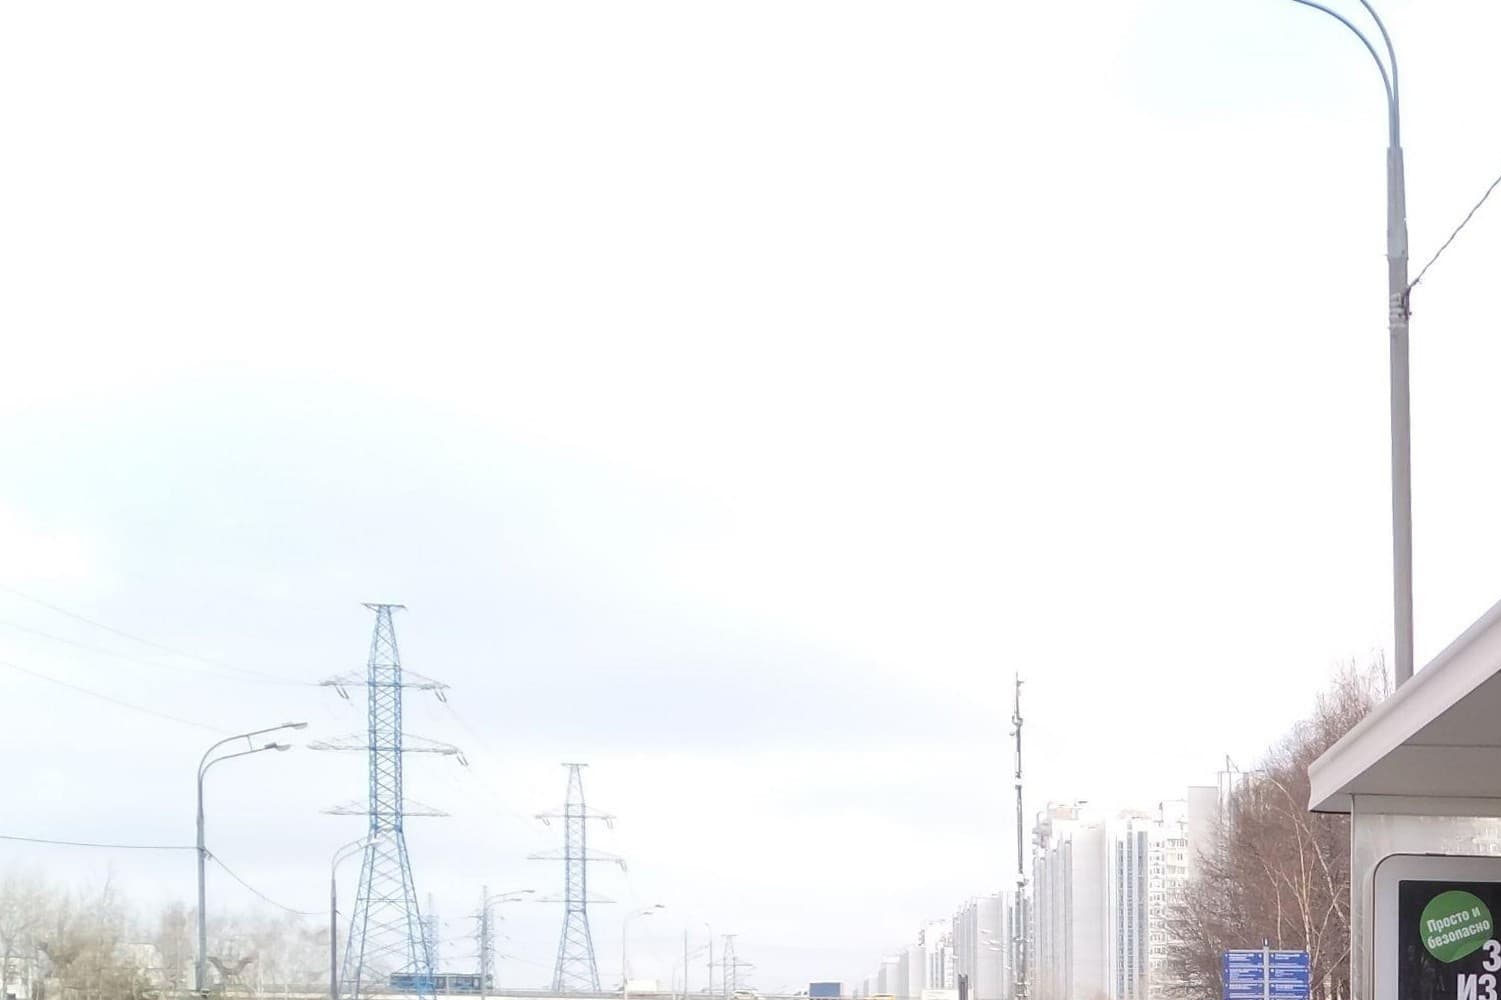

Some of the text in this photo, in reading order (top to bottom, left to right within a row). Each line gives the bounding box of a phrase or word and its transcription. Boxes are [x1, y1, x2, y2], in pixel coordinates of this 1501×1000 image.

[1426, 906, 1481, 933] Просто и
[1427, 919, 1491, 950] безопасно
